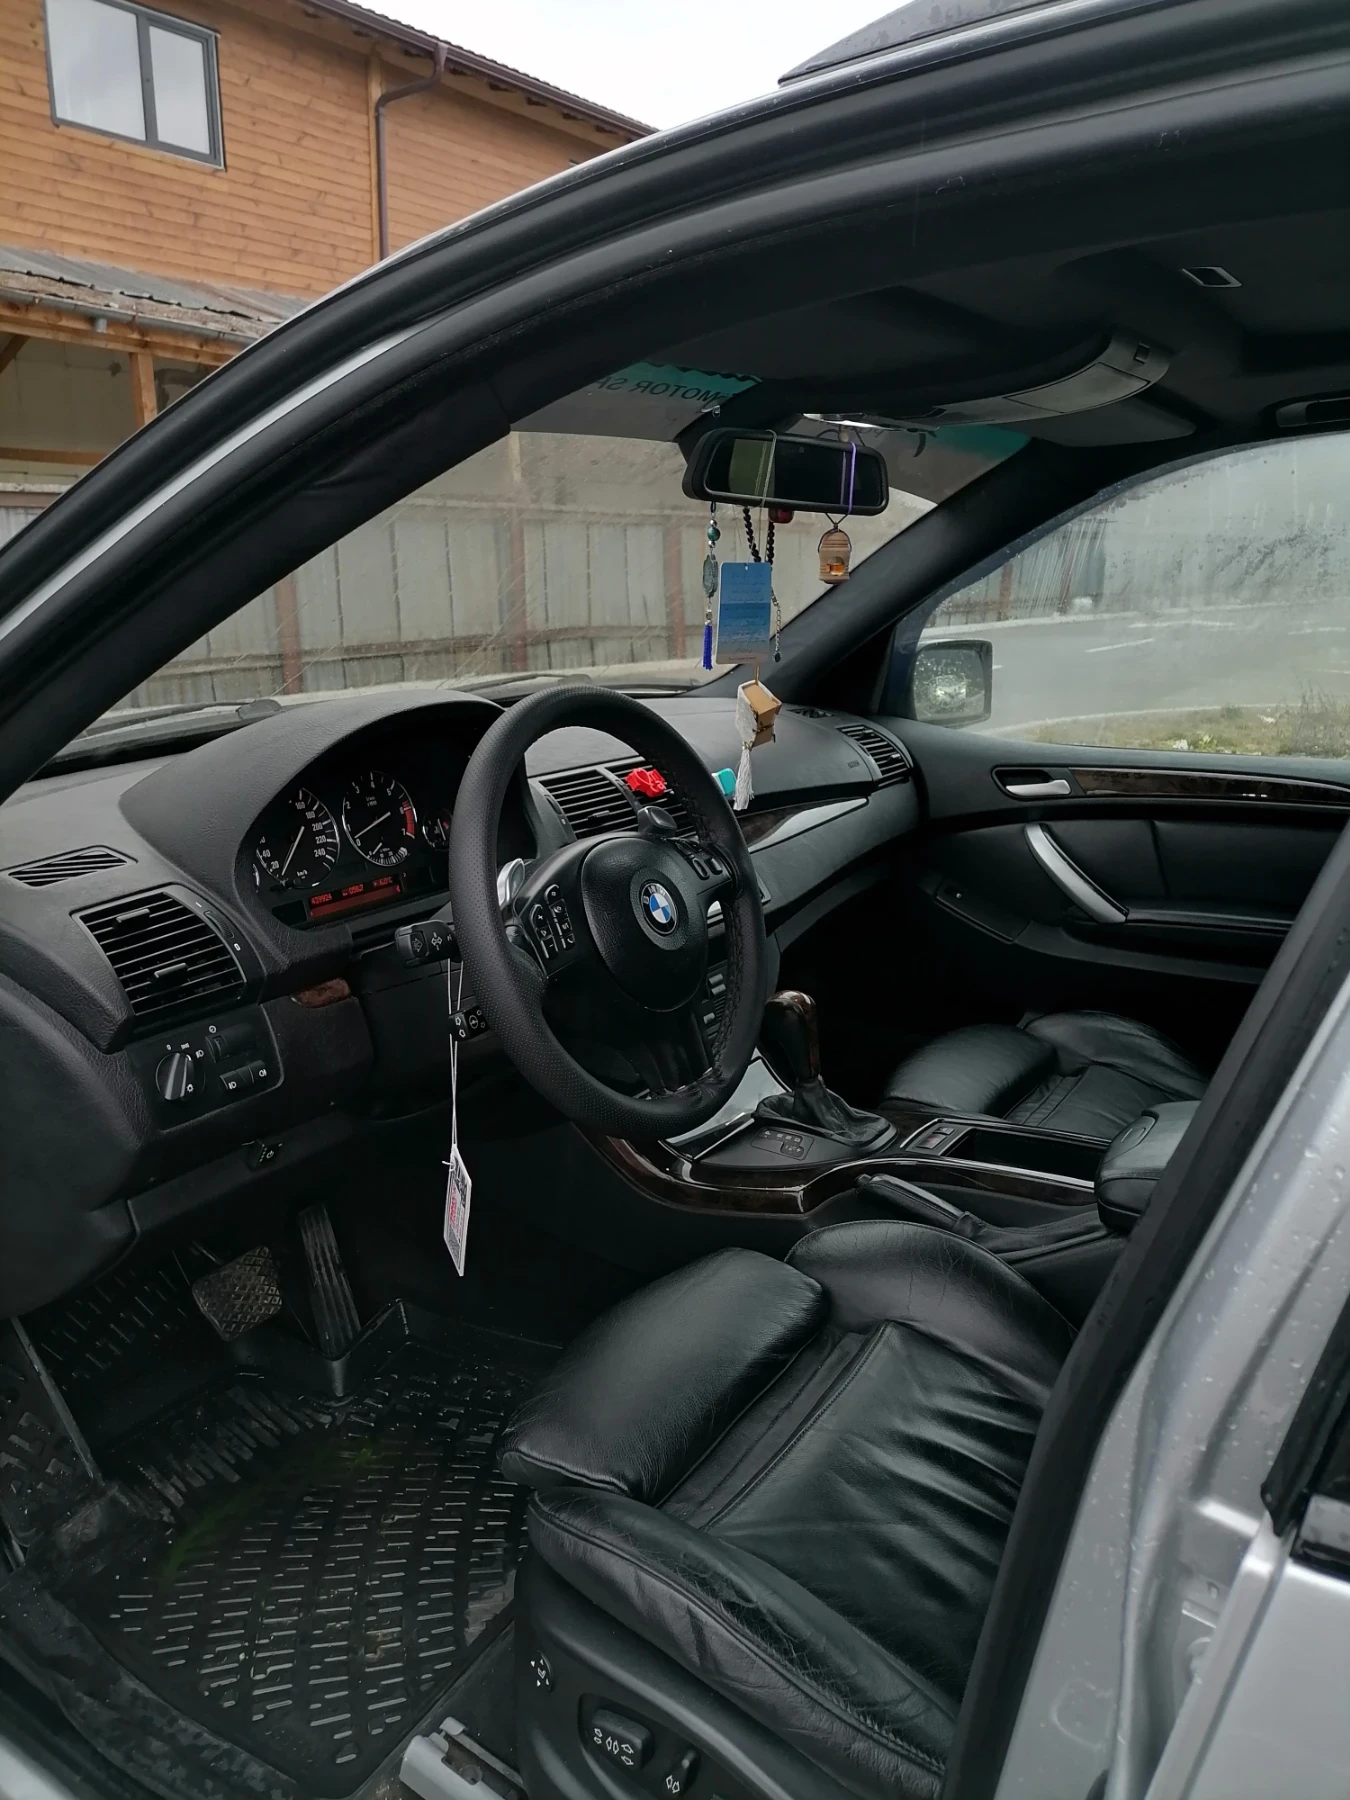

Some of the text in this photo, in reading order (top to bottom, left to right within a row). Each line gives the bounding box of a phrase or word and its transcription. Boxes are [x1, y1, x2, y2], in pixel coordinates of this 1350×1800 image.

[312, 822, 323, 832] 200
[315, 835, 327, 844] 220
[262, 849, 271, 858] 40
[314, 848, 326, 858] 240
[270, 860, 280, 870] 20
